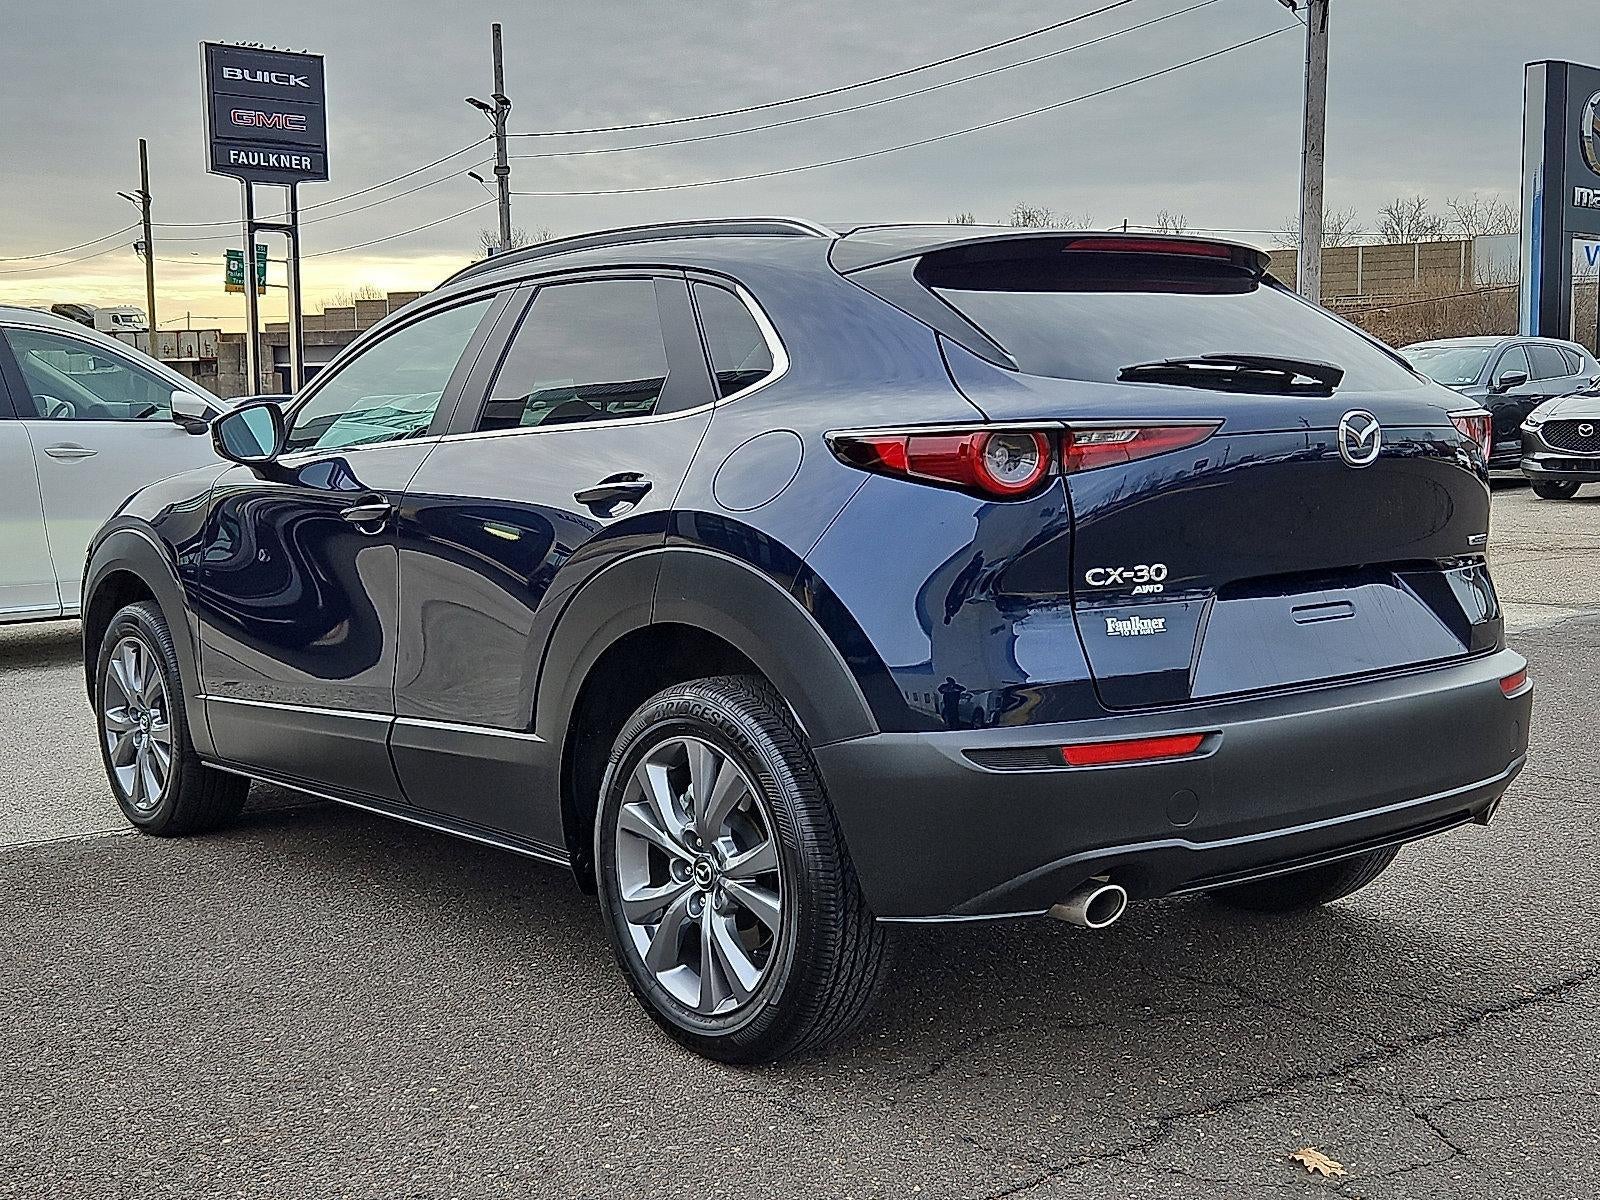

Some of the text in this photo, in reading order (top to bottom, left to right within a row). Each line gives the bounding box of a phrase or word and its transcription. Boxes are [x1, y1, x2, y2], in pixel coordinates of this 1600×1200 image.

[222, 66, 310, 88] BUICK
[230, 109, 307, 131] GMC
[229, 150, 311, 170] FAULKNER
[1085, 563, 1168, 586] CX-30
[1131, 583, 1164, 595] AWD
[1105, 615, 1166, 633] Faulkner
[653, 699, 757, 759] BRIDGESTONE
